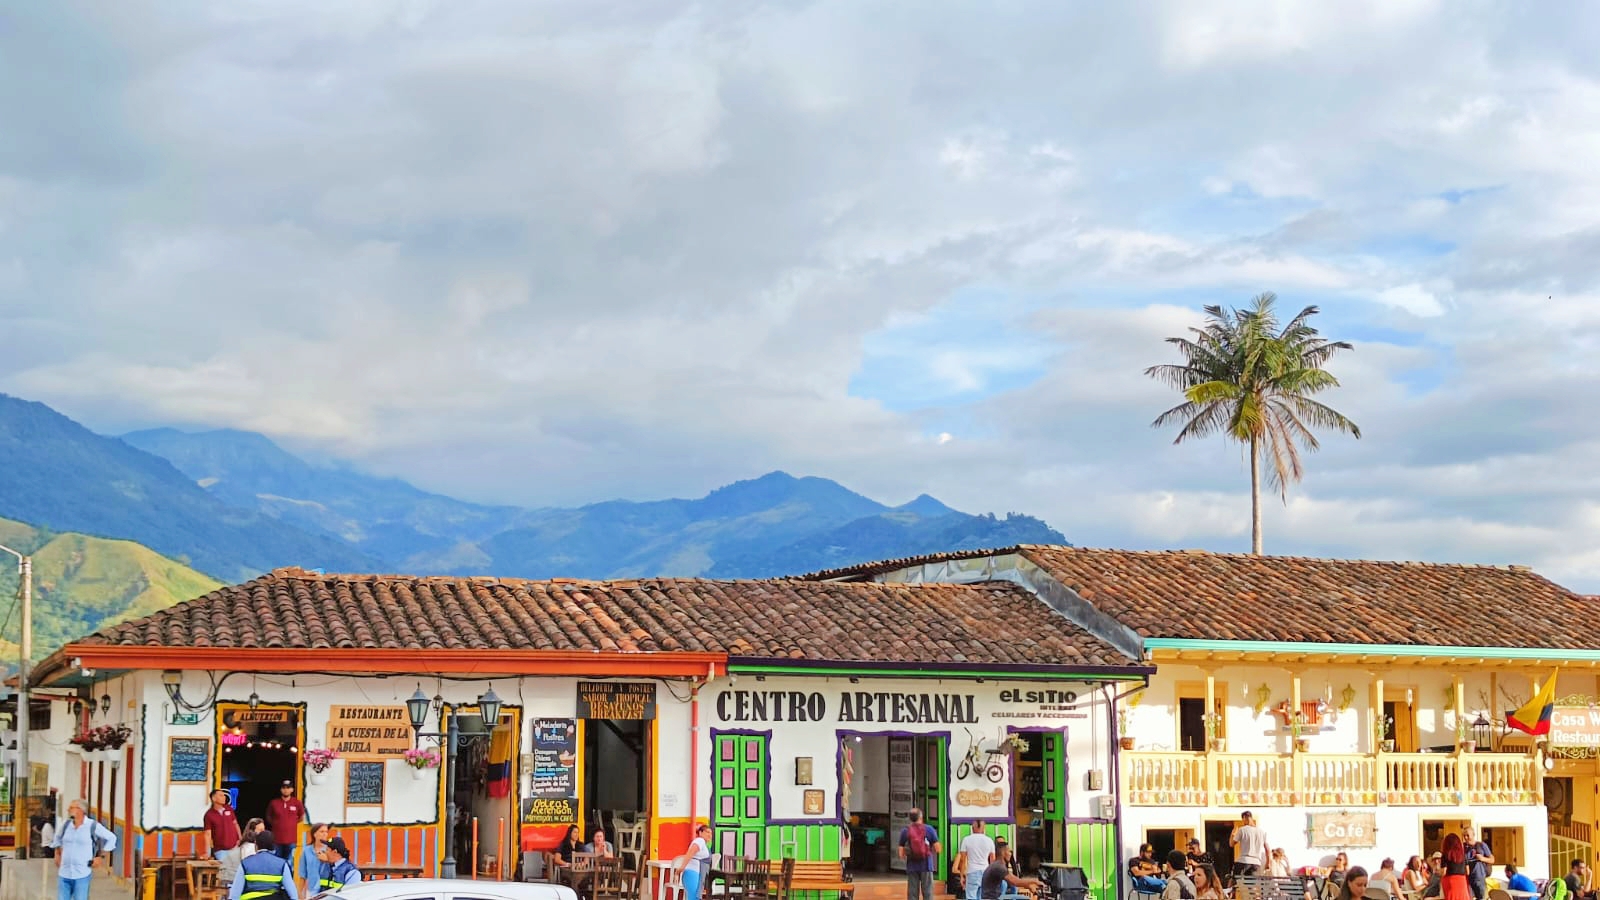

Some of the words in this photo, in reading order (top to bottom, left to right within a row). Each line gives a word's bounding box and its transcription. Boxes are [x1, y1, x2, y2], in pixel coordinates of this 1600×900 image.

[582, 693, 608, 702] SABOR
[615, 693, 651, 703] TROPICAL
[590, 702, 645, 711] DESAYUNOS
[716, 690, 826, 722] CENTRO
[837, 691, 980, 724] ARTESANAL
[339, 708, 403, 719] RESTAURANTE
[590, 710, 644, 719] BREAKFAST
[1550, 711, 1585, 727] Casa
[332, 727, 344, 738] LA
[348, 727, 382, 739] CUESTA
[383, 728, 397, 739] DE
[397, 728, 409, 739] LA
[335, 742, 371, 753] ABUELA
[1325, 823, 1364, 838] Café
